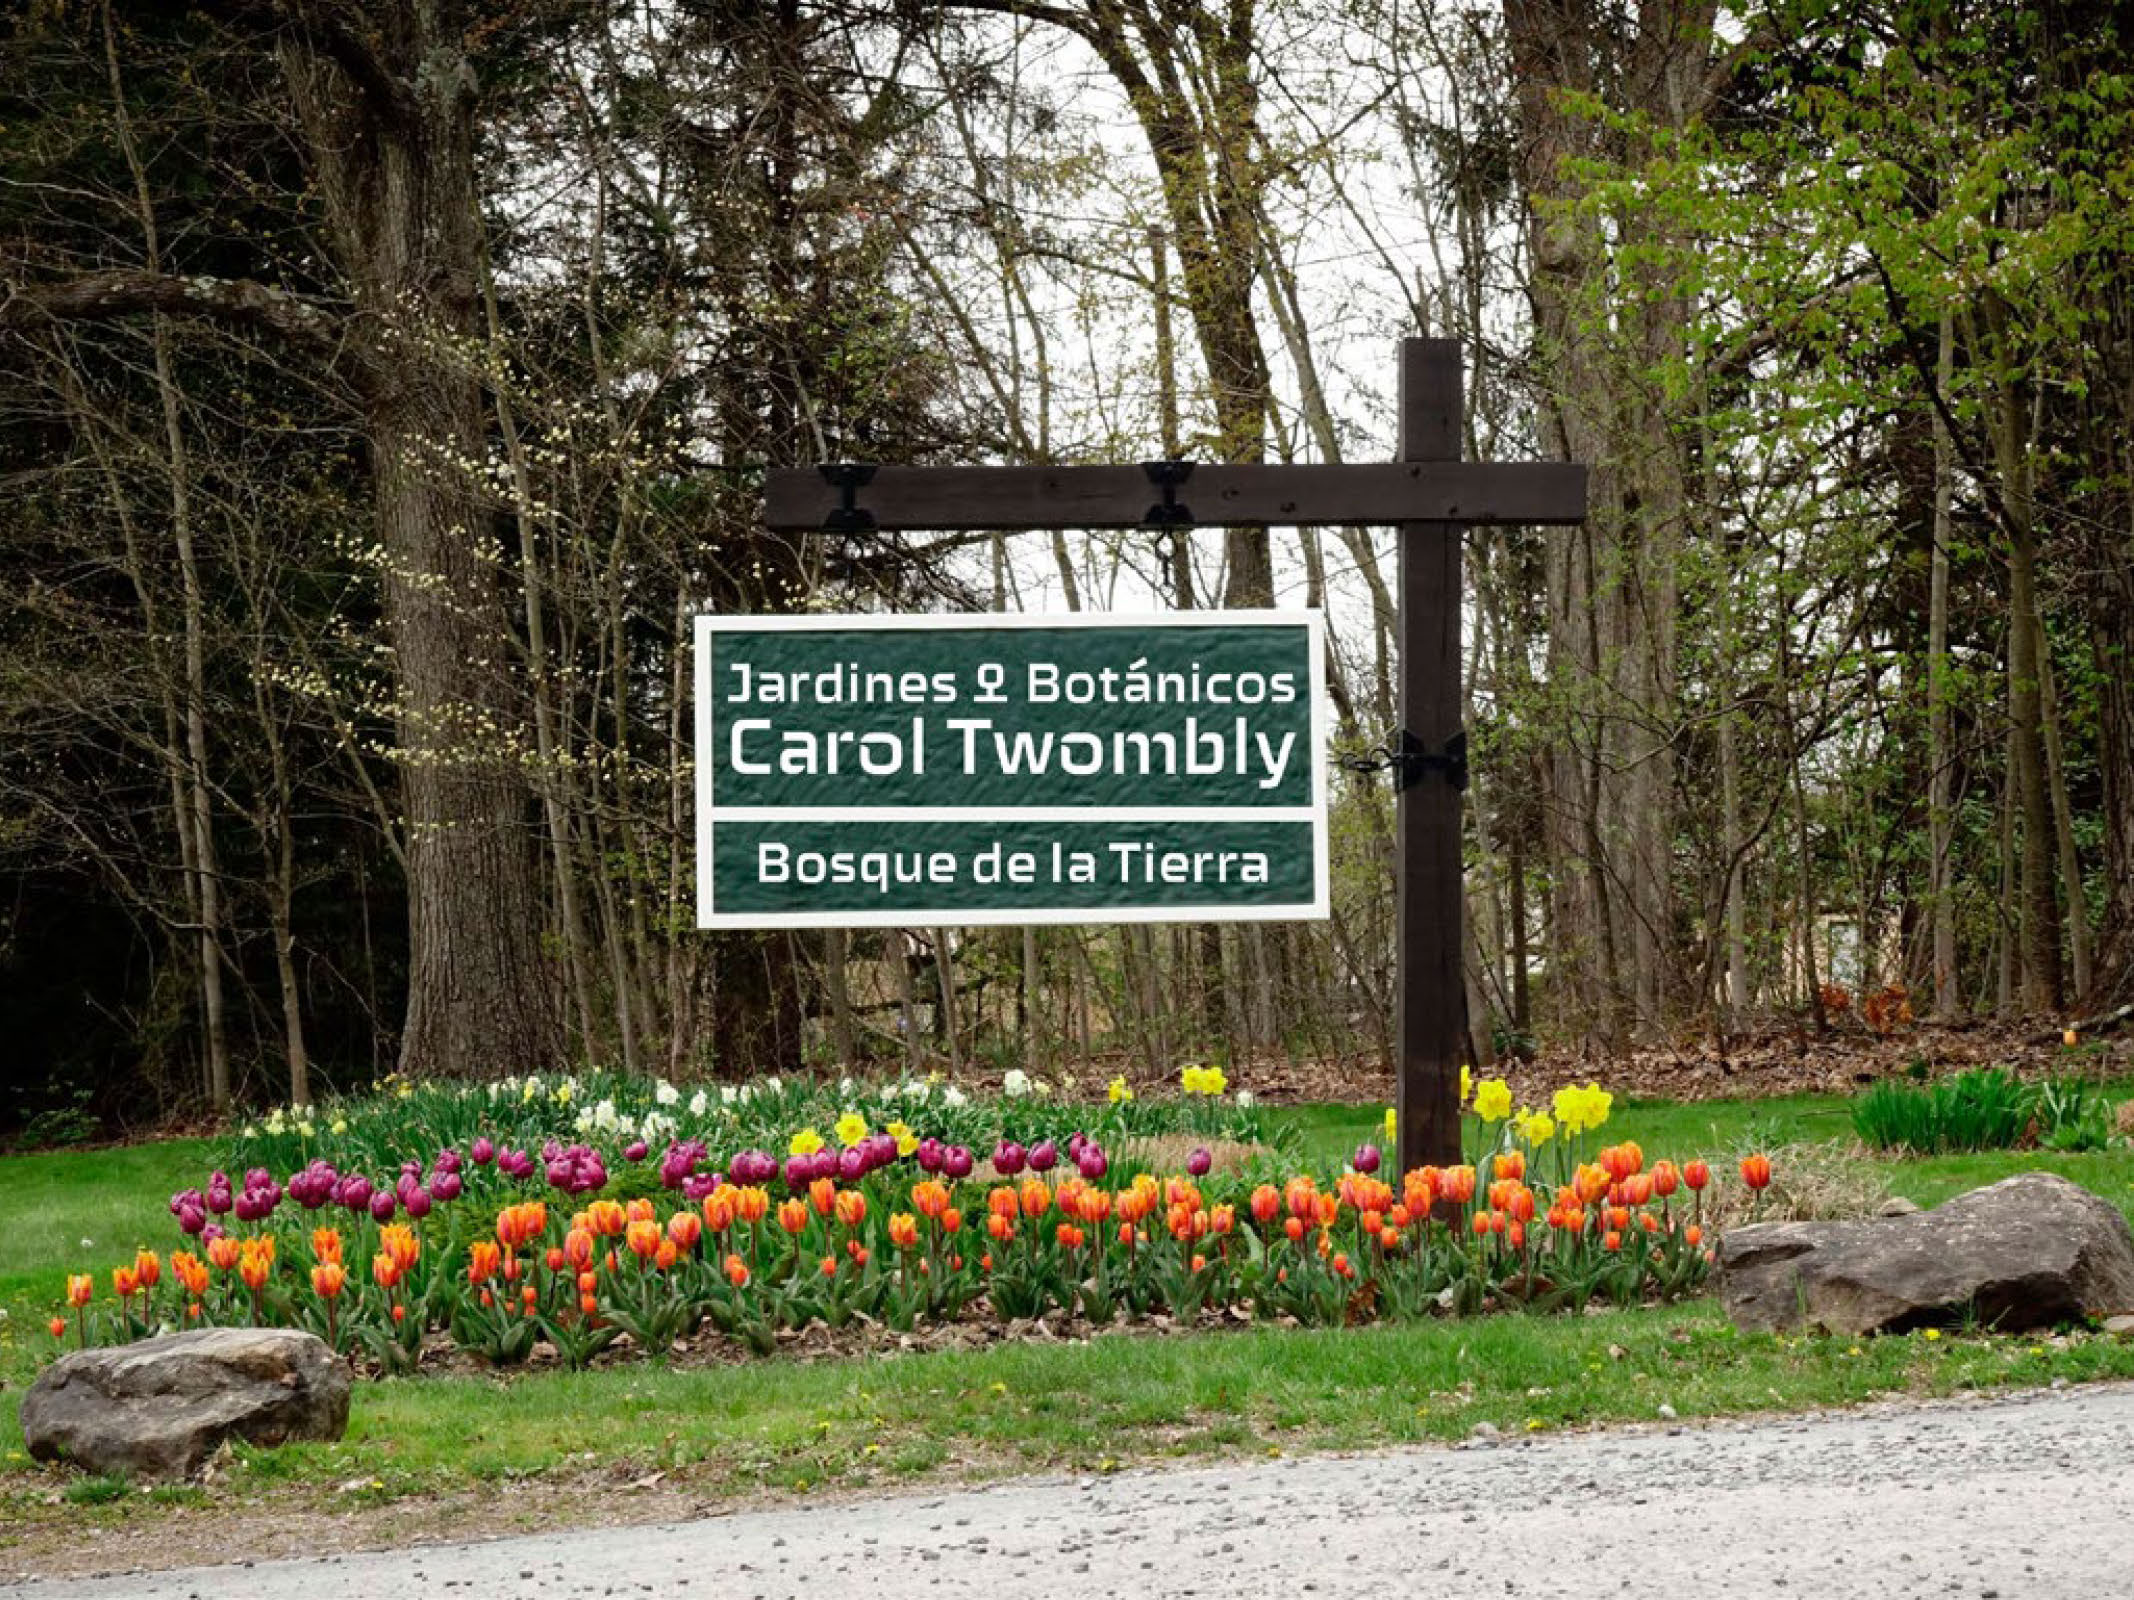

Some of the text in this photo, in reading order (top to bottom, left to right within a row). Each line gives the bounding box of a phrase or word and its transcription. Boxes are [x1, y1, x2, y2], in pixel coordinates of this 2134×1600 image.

[727, 656, 1296, 703] Jardines Botánicos
[730, 716, 1297, 789] Carol Twombly
[758, 842, 1269, 893] Bosque de la Tierra
